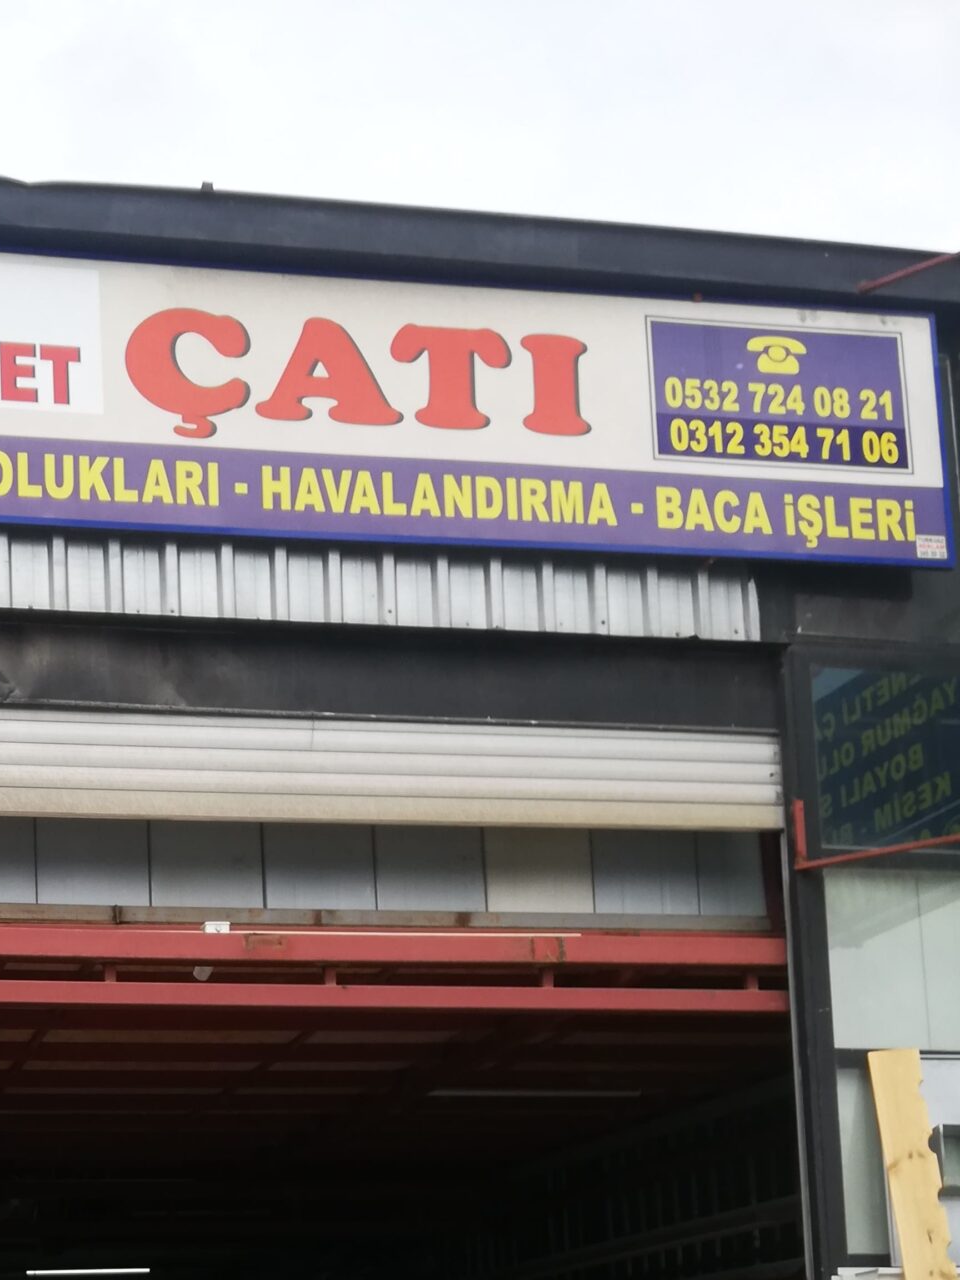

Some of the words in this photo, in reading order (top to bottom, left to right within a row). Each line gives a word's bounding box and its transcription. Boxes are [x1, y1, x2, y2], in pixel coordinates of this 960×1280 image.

[125, 307, 594, 438] ÇATI
[665, 376, 739, 412] 0532
[749, 383, 805, 415] 724
[814, 386, 850, 419] 08
[860, 389, 893, 421] 21
[669, 418, 745, 455] 0312
[753, 423, 809, 459] 354
[817, 427, 851, 461] 71
[861, 430, 899, 464] 06
[260, 465, 617, 526] HAVALANDIRMA
[655, 486, 773, 535] BACA
